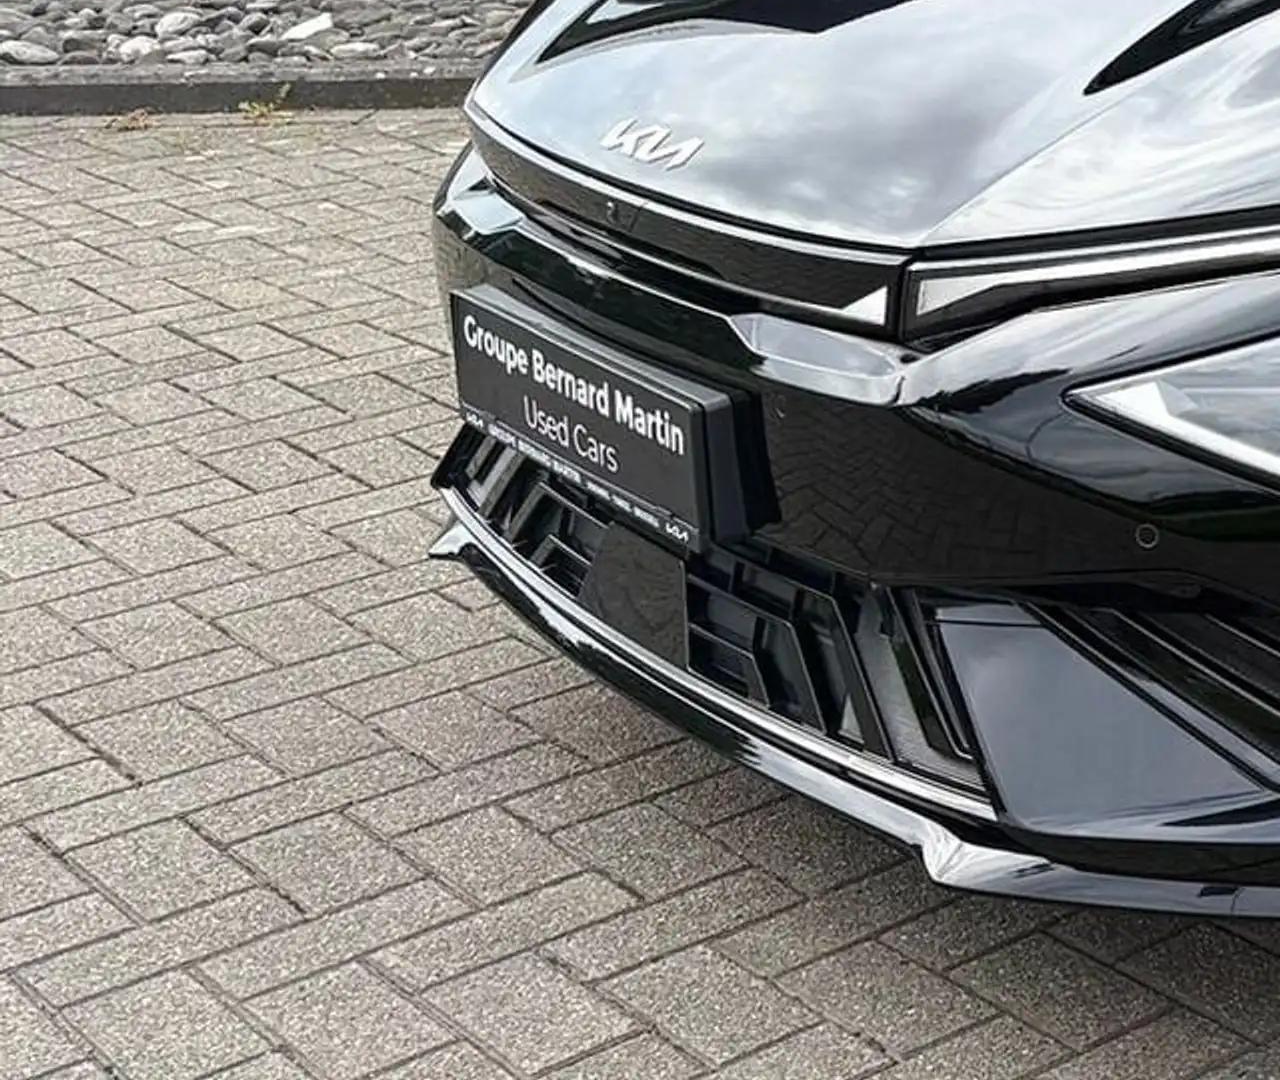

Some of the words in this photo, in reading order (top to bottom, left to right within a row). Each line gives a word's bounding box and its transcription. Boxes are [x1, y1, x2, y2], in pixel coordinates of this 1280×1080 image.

[599, 117, 706, 171] KIA
[463, 314, 529, 375] Groupe
[531, 347, 611, 418] Bernard
[614, 388, 685, 456] Martin
[523, 394, 570, 449] Used
[573, 423, 620, 473] Cars
